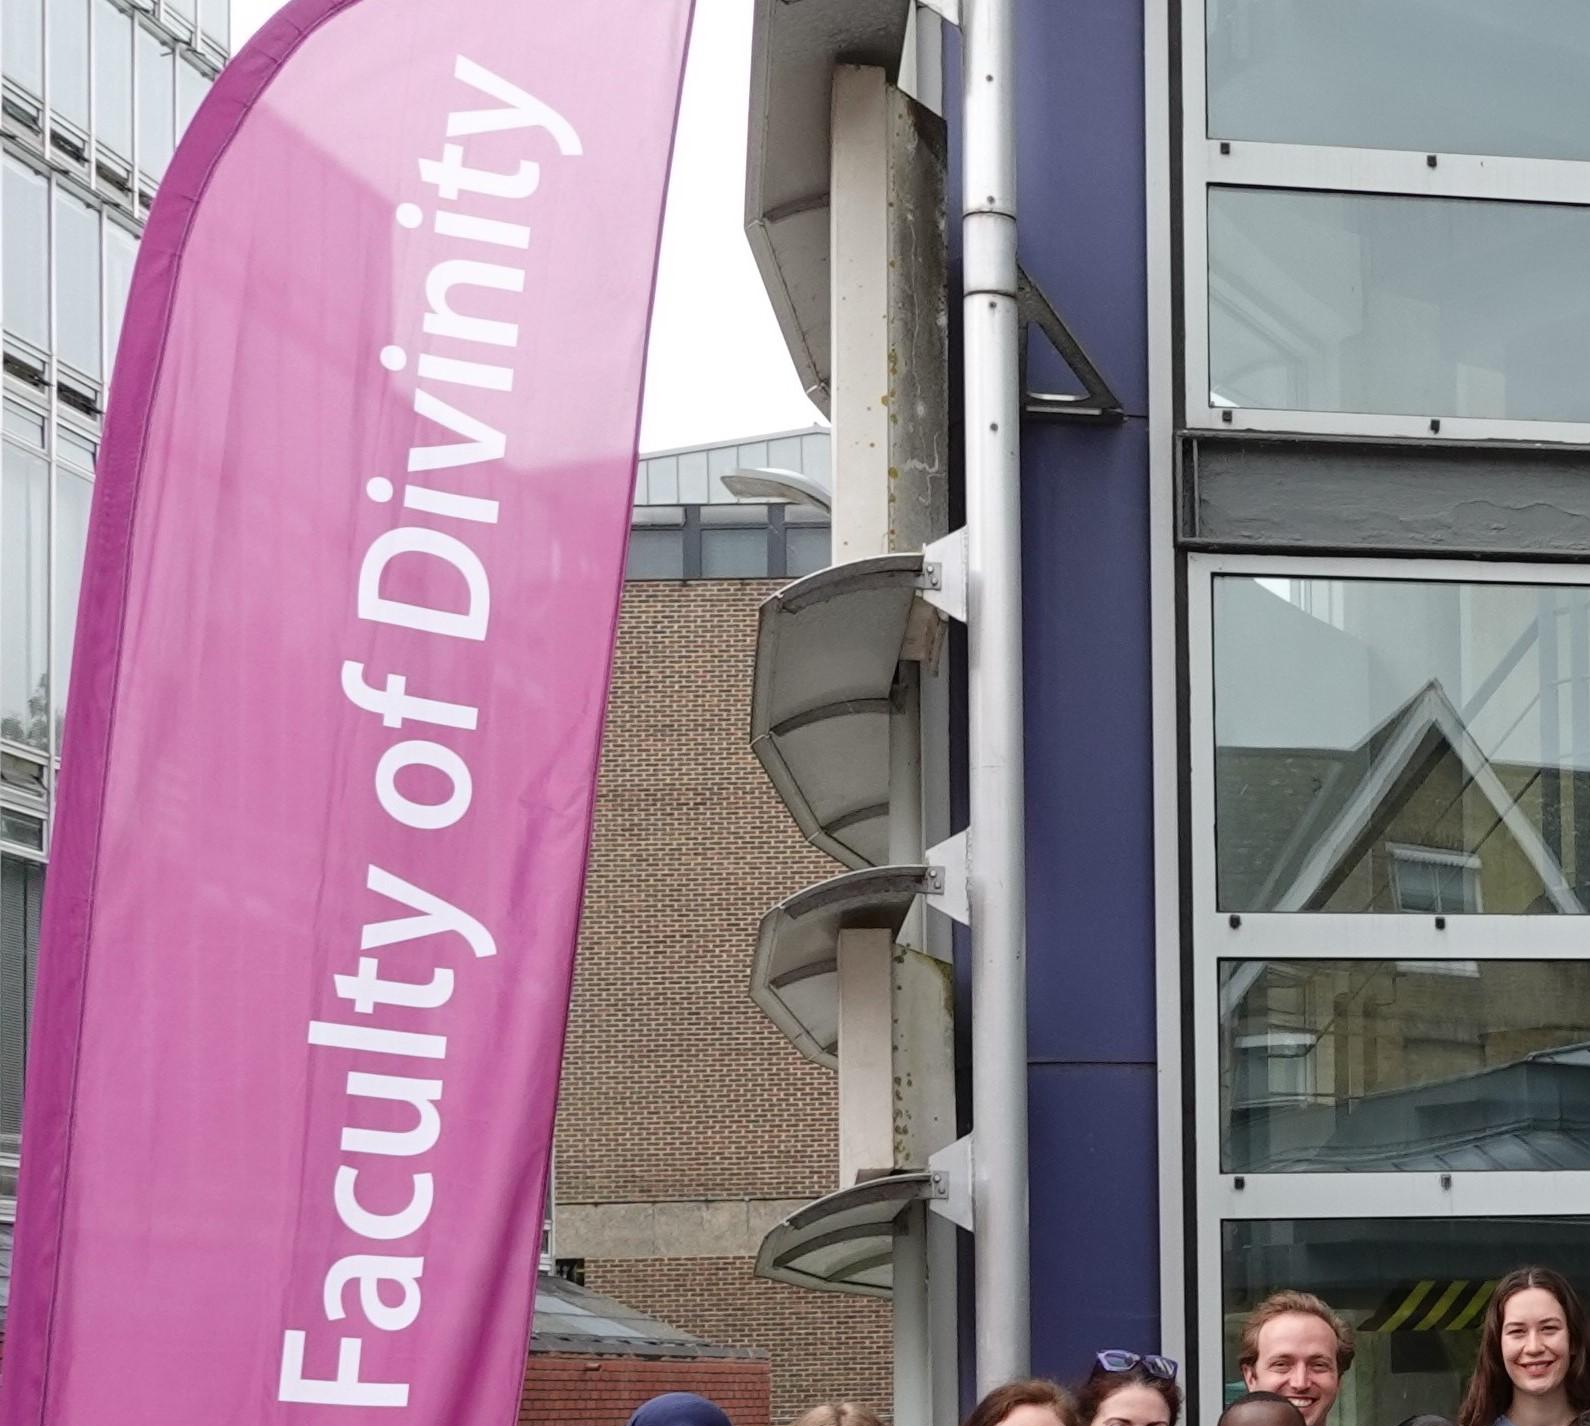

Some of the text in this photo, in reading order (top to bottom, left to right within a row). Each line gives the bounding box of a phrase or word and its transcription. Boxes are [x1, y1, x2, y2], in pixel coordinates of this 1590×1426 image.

[281, 54, 582, 1407] Faculty of Divinity
